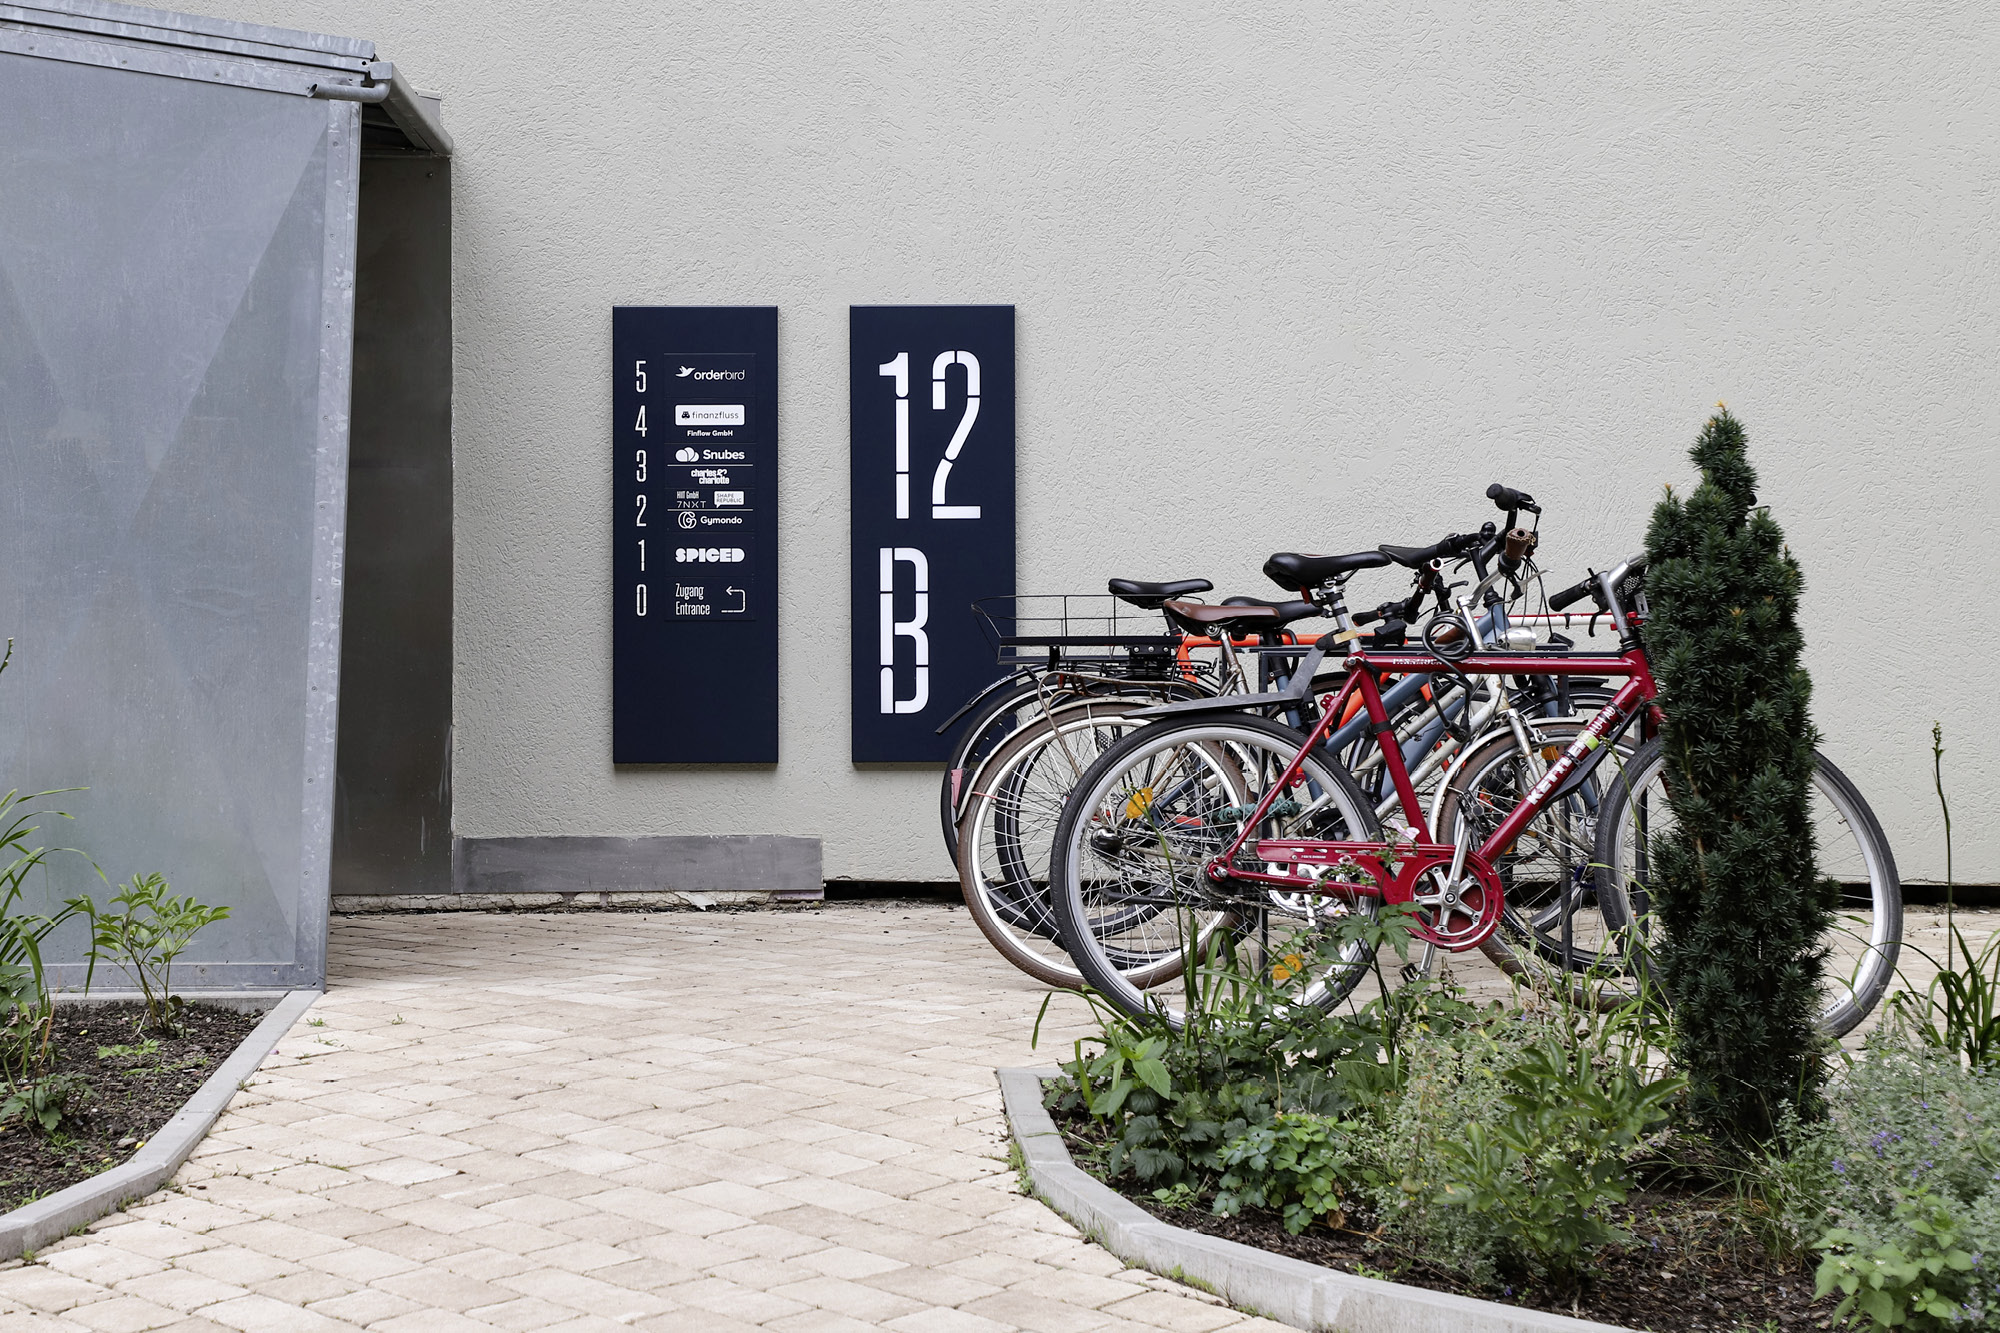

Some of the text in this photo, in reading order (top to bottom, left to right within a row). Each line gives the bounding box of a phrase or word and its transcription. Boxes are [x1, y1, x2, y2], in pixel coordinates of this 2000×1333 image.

[635, 360, 647, 393] 5
[694, 369, 745, 380] orderbird
[635, 405, 647, 438] 4
[691, 411, 739, 419] finanzfluss
[878, 350, 981, 520] 12
[703, 450, 745, 460] Snubes
[636, 449, 647, 482] 3
[691, 468, 716, 477] charles
[699, 475, 730, 484] charlotte
[636, 494, 647, 527] 2
[700, 516, 743, 525] Gymondo
[637, 539, 645, 572] 1
[675, 548, 745, 563] SPICED
[636, 583, 647, 617] 0
[675, 583, 705, 600] Zugang
[675, 601, 711, 615] Entrance
[879, 547, 930, 714] B
